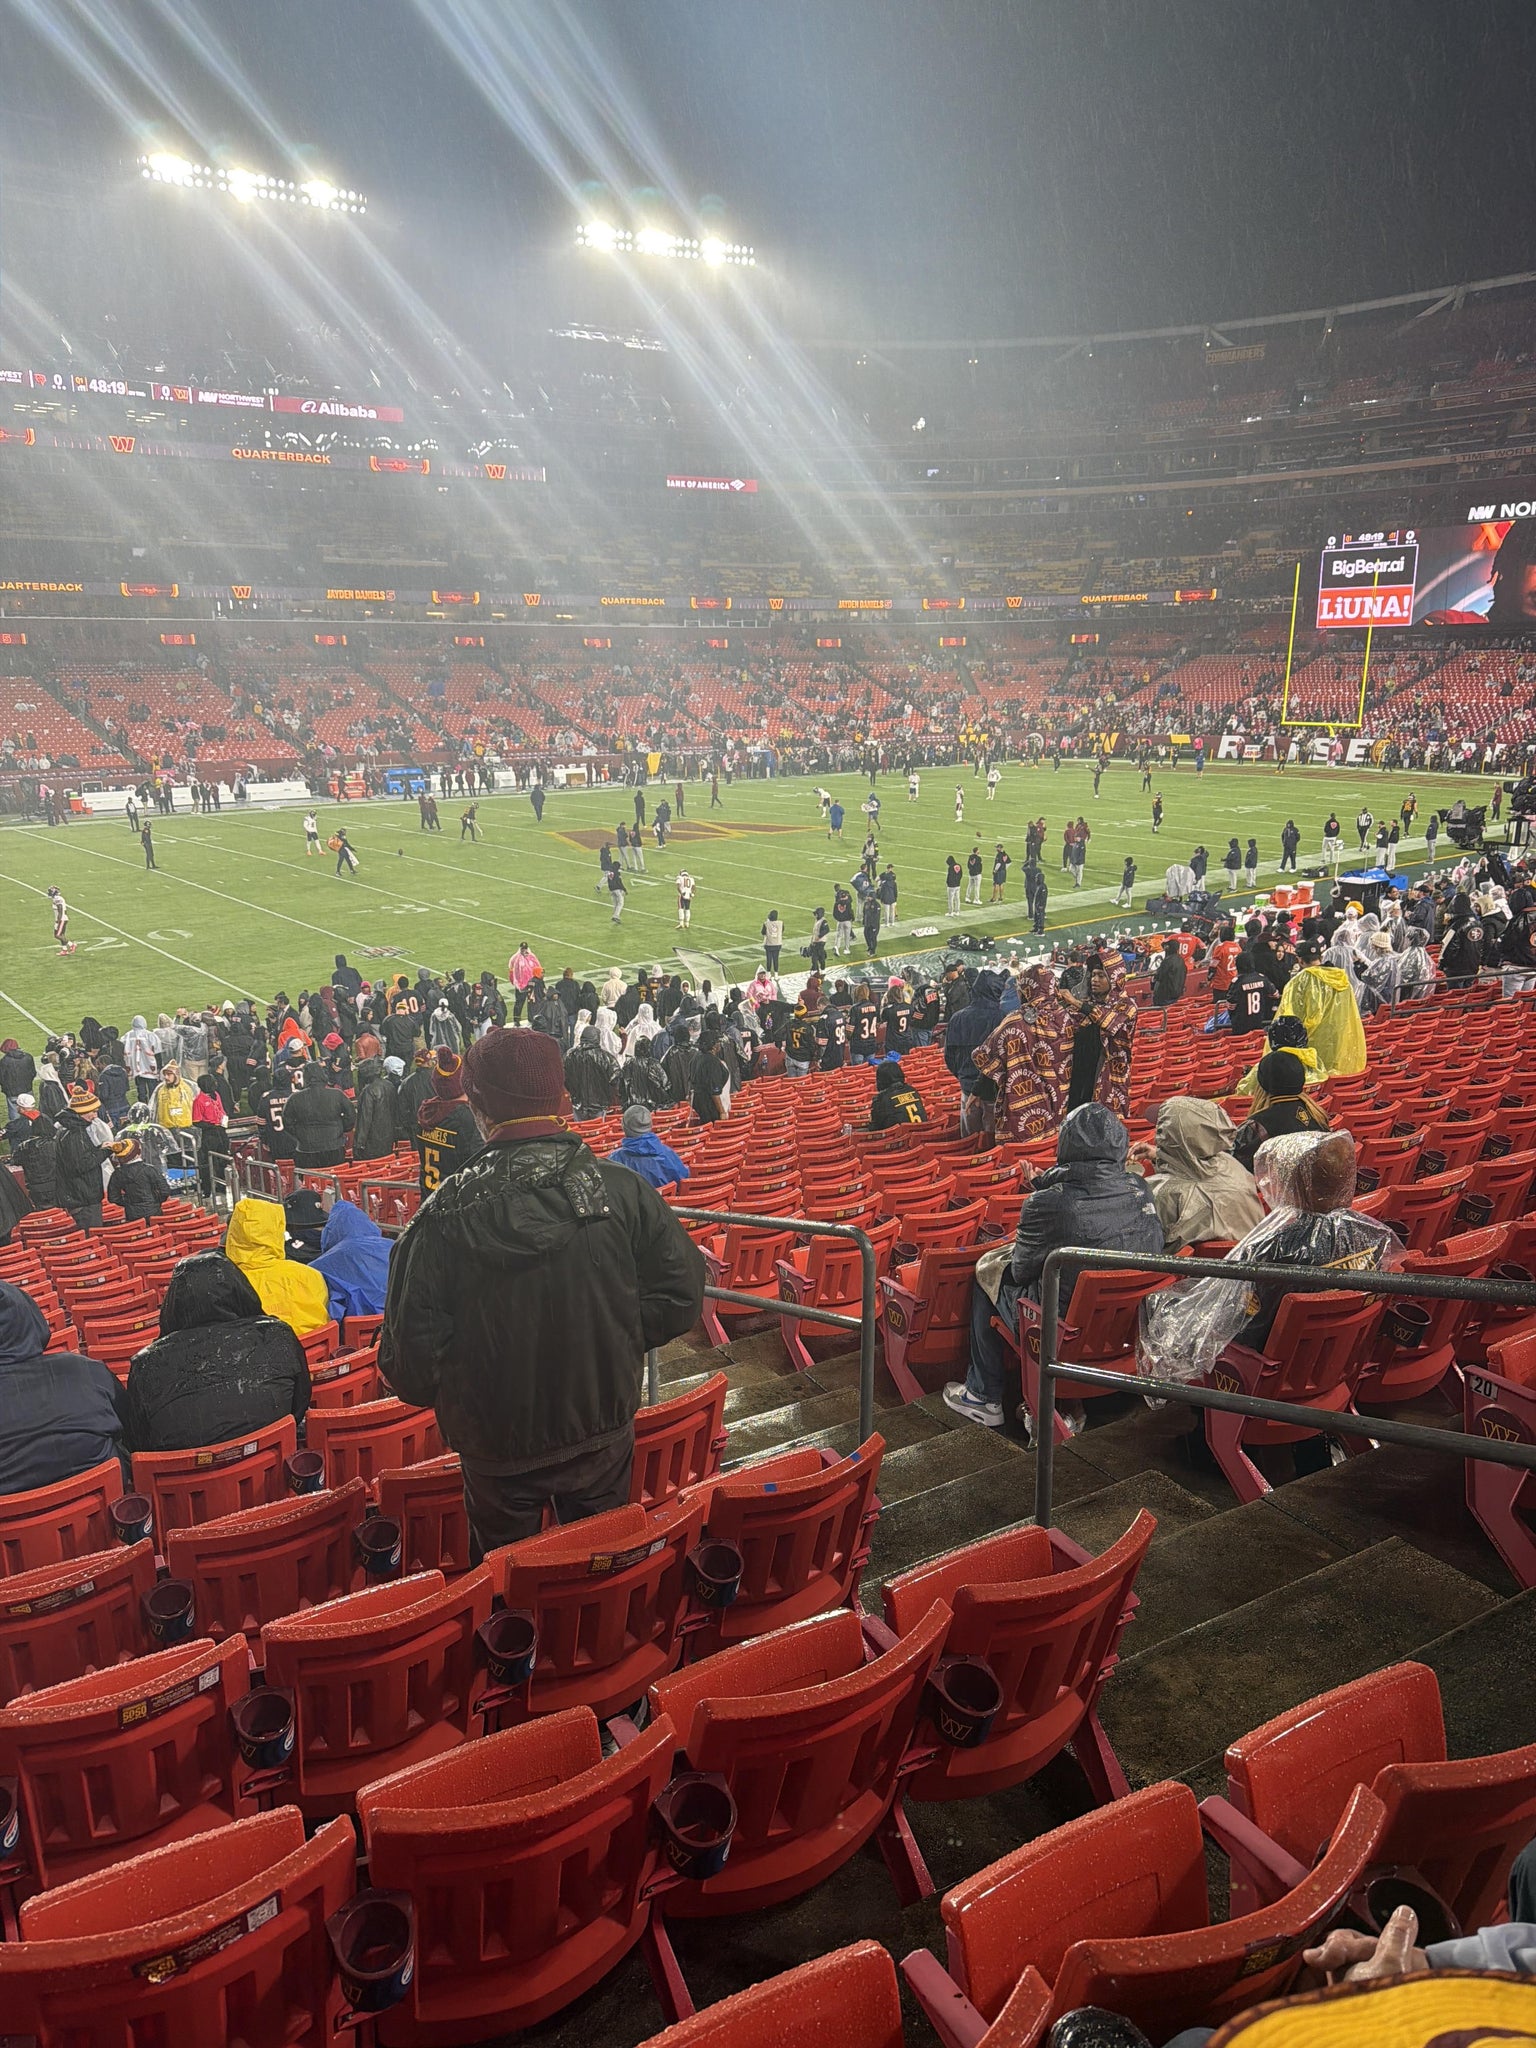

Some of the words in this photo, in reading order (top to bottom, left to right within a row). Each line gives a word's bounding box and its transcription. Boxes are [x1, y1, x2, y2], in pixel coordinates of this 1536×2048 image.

[1207, 348, 1265, 363] COMMANDERS
[90, 379, 126, 395] 48:19
[319, 402, 377, 419] Alibaba
[231, 448, 332, 464] QUARTERBACK
[697, 481, 730, 490] AMERICA
[1332, 556, 1405, 578] BigBear.ai
[327, 589, 354, 600] JAYDEN
[355, 590, 386, 600] DANIELS
[600, 597, 666, 606] QUARTERBACK
[1080, 593, 1150, 604] QUARTERBACK
[1320, 595, 1411, 620] LiUNA!
[1178, 943, 1189, 955] 18
[1242, 981, 1265, 991] WILLIAMS
[1247, 992, 1261, 1016] 18
[860, 1016, 878, 1039] 34
[899, 1017, 907, 1032] 9
[999, 1027, 1028, 1056] WASHINGTON
[1005, 1068, 1042, 1094] WASHINGTON
[1018, 1108, 1054, 1133] WASHINGTON
[425, 1146, 440, 1191] 5
[1025, 1307, 1035, 1320] 18
[1473, 1376, 1492, 1397] 20
